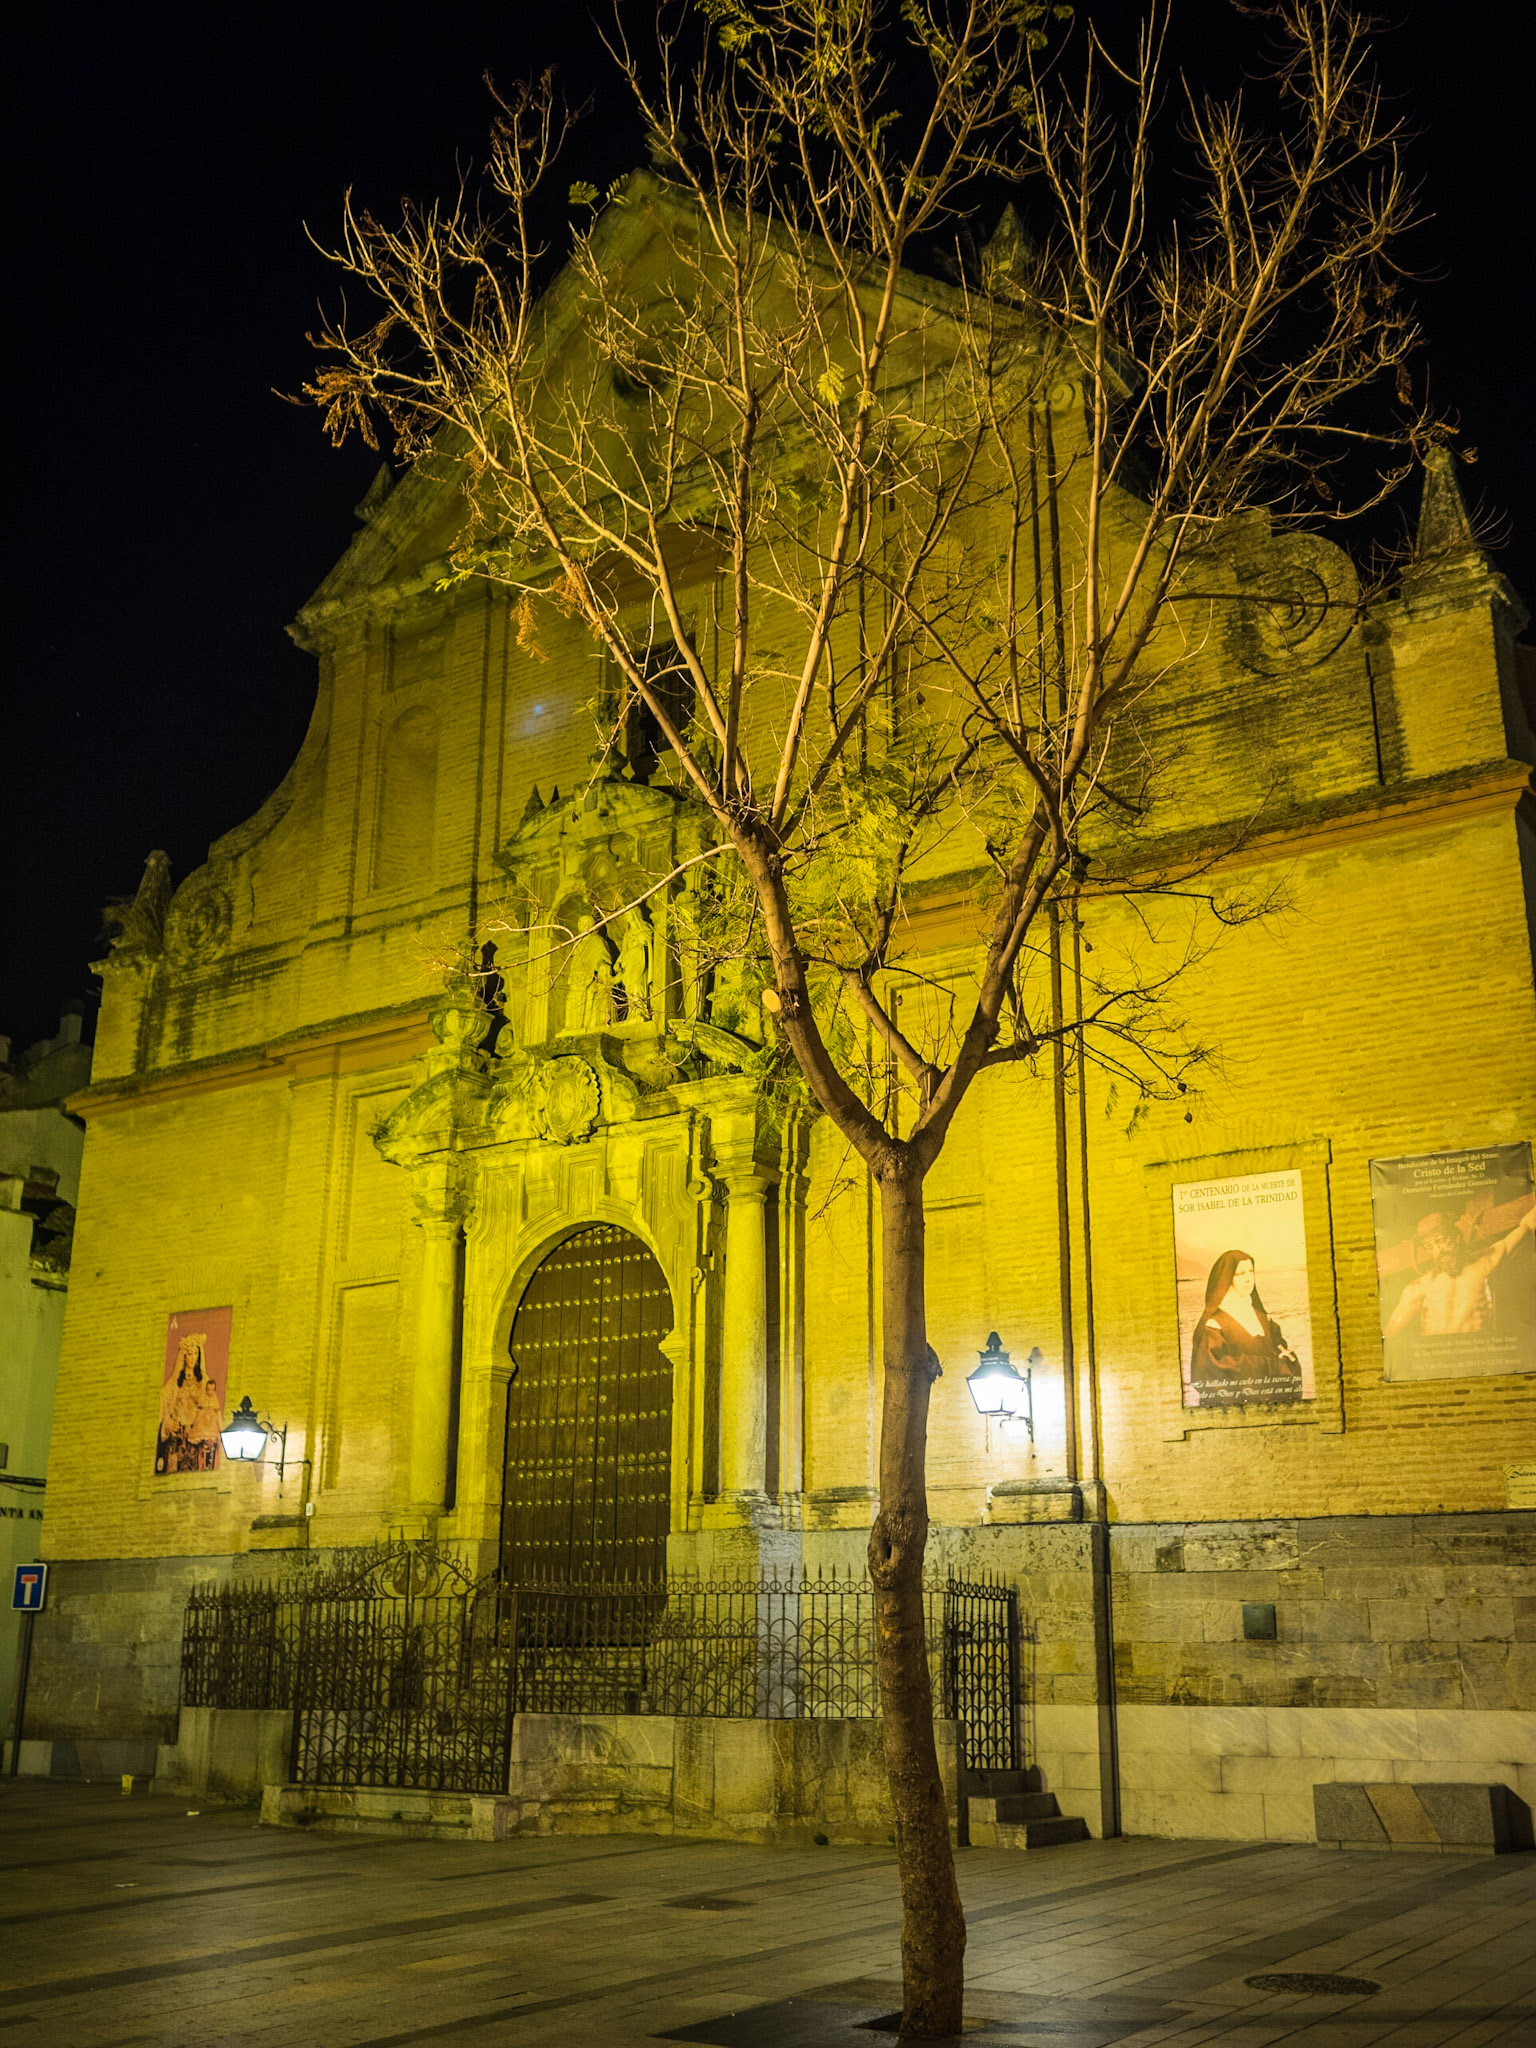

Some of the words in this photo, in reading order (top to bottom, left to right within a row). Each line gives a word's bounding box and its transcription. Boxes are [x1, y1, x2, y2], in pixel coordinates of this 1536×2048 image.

[1413, 1168, 1441, 1178] Cristo
[1444, 1166, 1455, 1174] de
[1457, 1164, 1466, 1173] la
[1468, 1161, 1486, 1171] Sed
[1190, 1184, 1239, 1199] CENTENARIO
[1242, 1185, 1250, 1193] DE
[1261, 1180, 1285, 1190] MUERTE
[1287, 1179, 1295, 1187] DE
[1178, 1204, 1195, 1213] SOR
[1198, 1200, 1226, 1212] ISABEL
[1228, 1198, 1240, 1208] DE
[1242, 1197, 1253, 1206] LA
[1255, 1191, 1298, 1204] TRINIDAD
[1264, 1376, 1271, 1384] la
